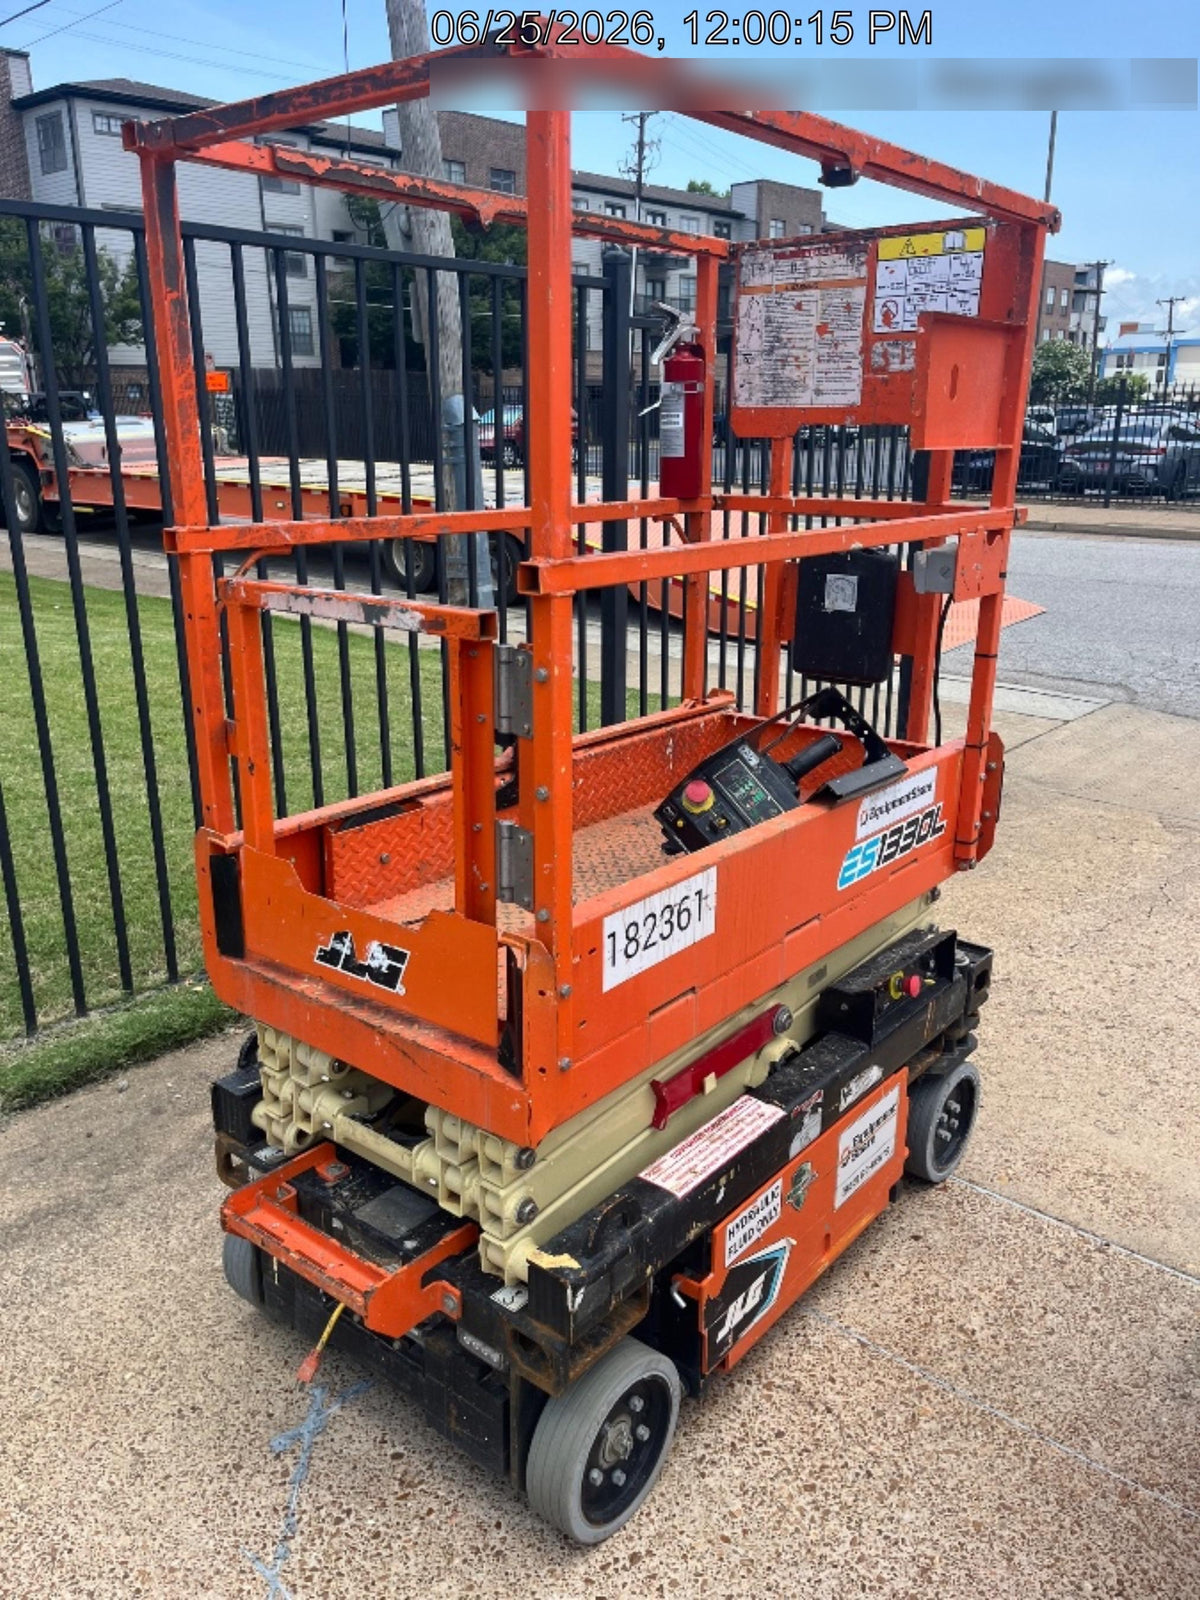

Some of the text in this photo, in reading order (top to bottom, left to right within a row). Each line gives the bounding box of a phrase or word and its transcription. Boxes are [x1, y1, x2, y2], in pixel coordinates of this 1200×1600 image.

[838, 804, 946, 889] ES1330L
[607, 888, 703, 968] 182361
[728, 1184, 780, 1239] HYDRAULIC
[728, 1203, 780, 1259] FLUID ONLY
